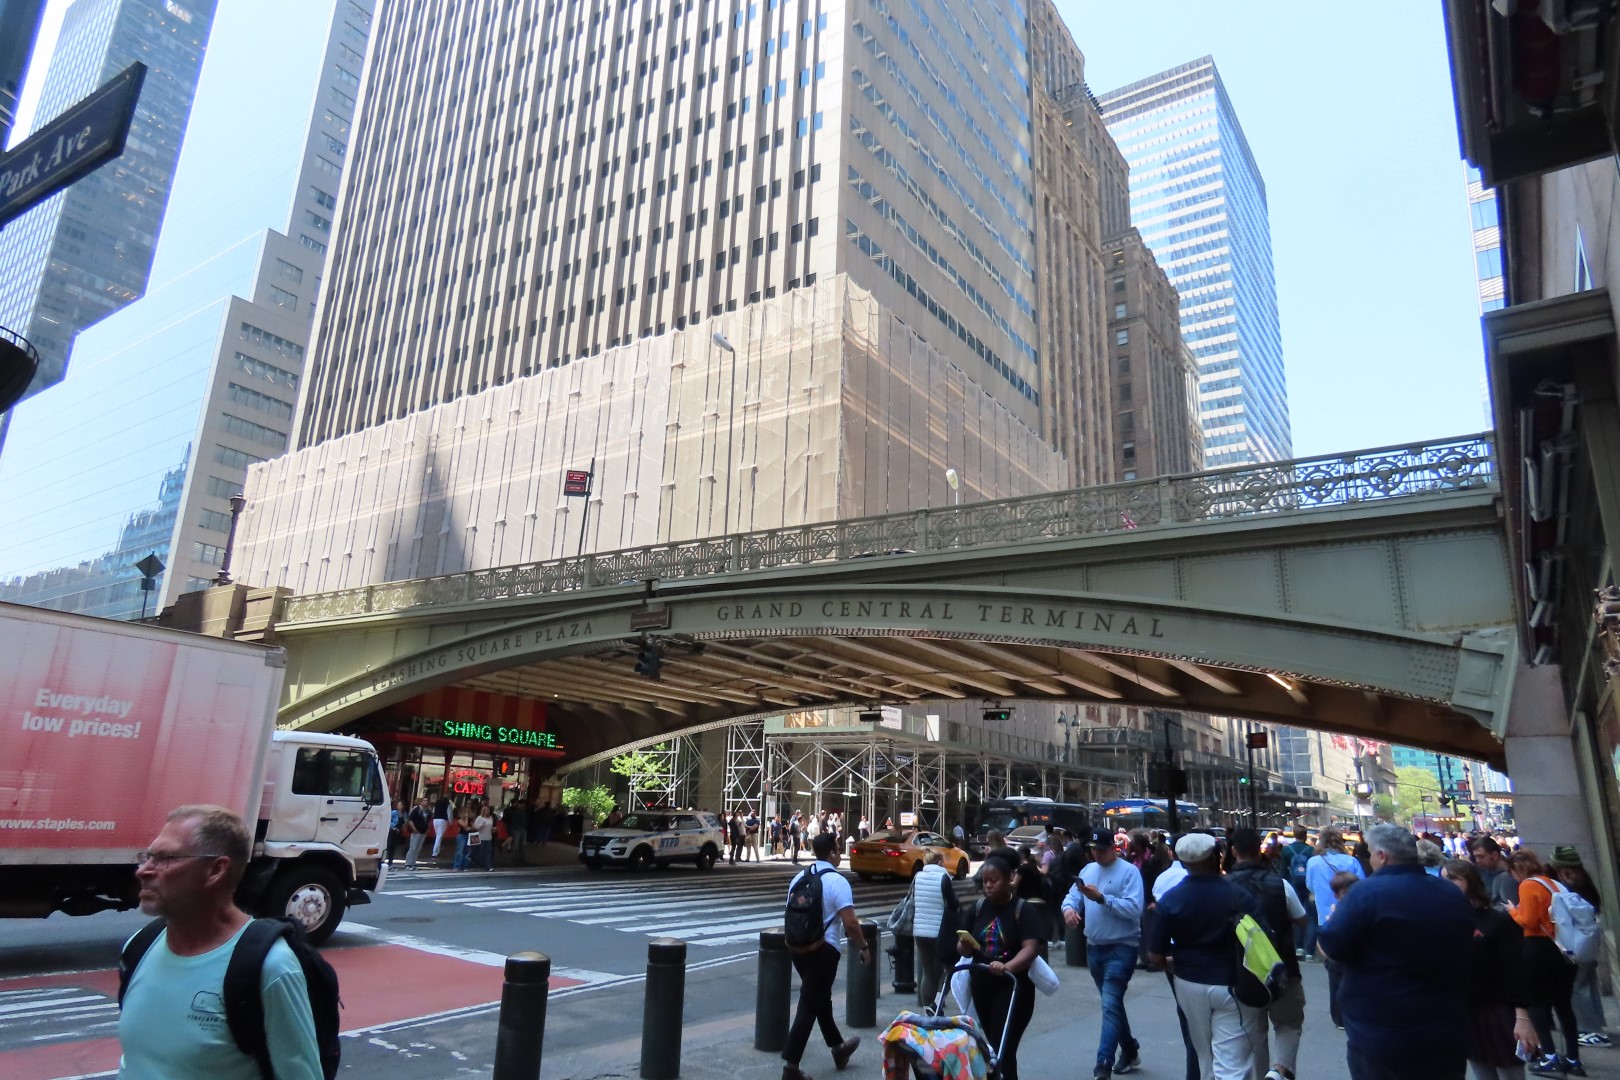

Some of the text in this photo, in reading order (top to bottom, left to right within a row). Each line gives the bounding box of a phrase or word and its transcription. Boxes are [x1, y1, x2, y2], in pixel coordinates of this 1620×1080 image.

[0, 126, 91, 197] Park Ave
[717, 600, 1164, 638] GRAND CENTRAL TERMINAL
[372, 620, 593, 692] PERSHING SQUARE PLAZA
[35, 687, 133, 719] Everyday
[22, 711, 142, 739] low prices!
[412, 716, 556, 748] PERSHING SQUARE
[0, 818, 116, 831] www.staples.com
[660, 837, 680, 849] NYPD
